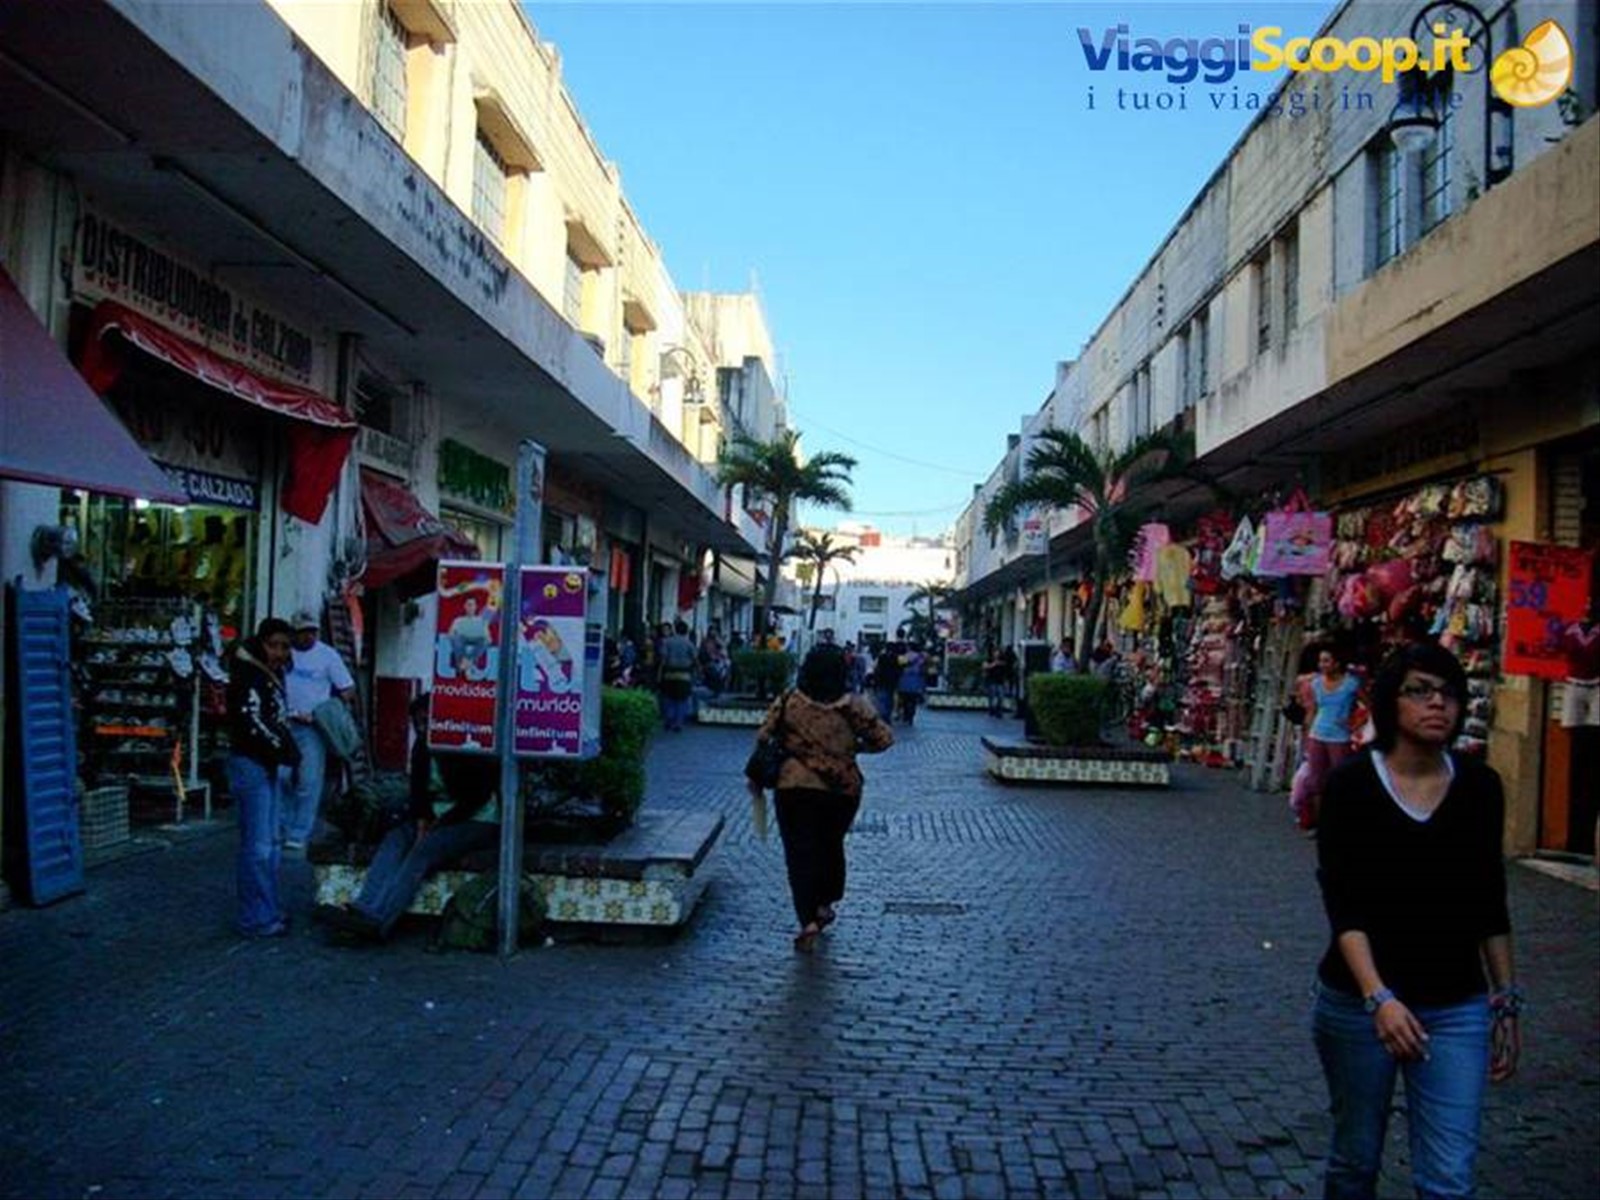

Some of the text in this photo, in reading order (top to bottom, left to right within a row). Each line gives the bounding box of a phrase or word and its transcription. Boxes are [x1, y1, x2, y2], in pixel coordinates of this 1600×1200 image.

[188, 473, 255, 507] CALZADO
[432, 683, 496, 698] movilidad
[517, 698, 581, 713] mundo
[430, 719, 492, 734] infinitum
[516, 726, 578, 740] infinitum
